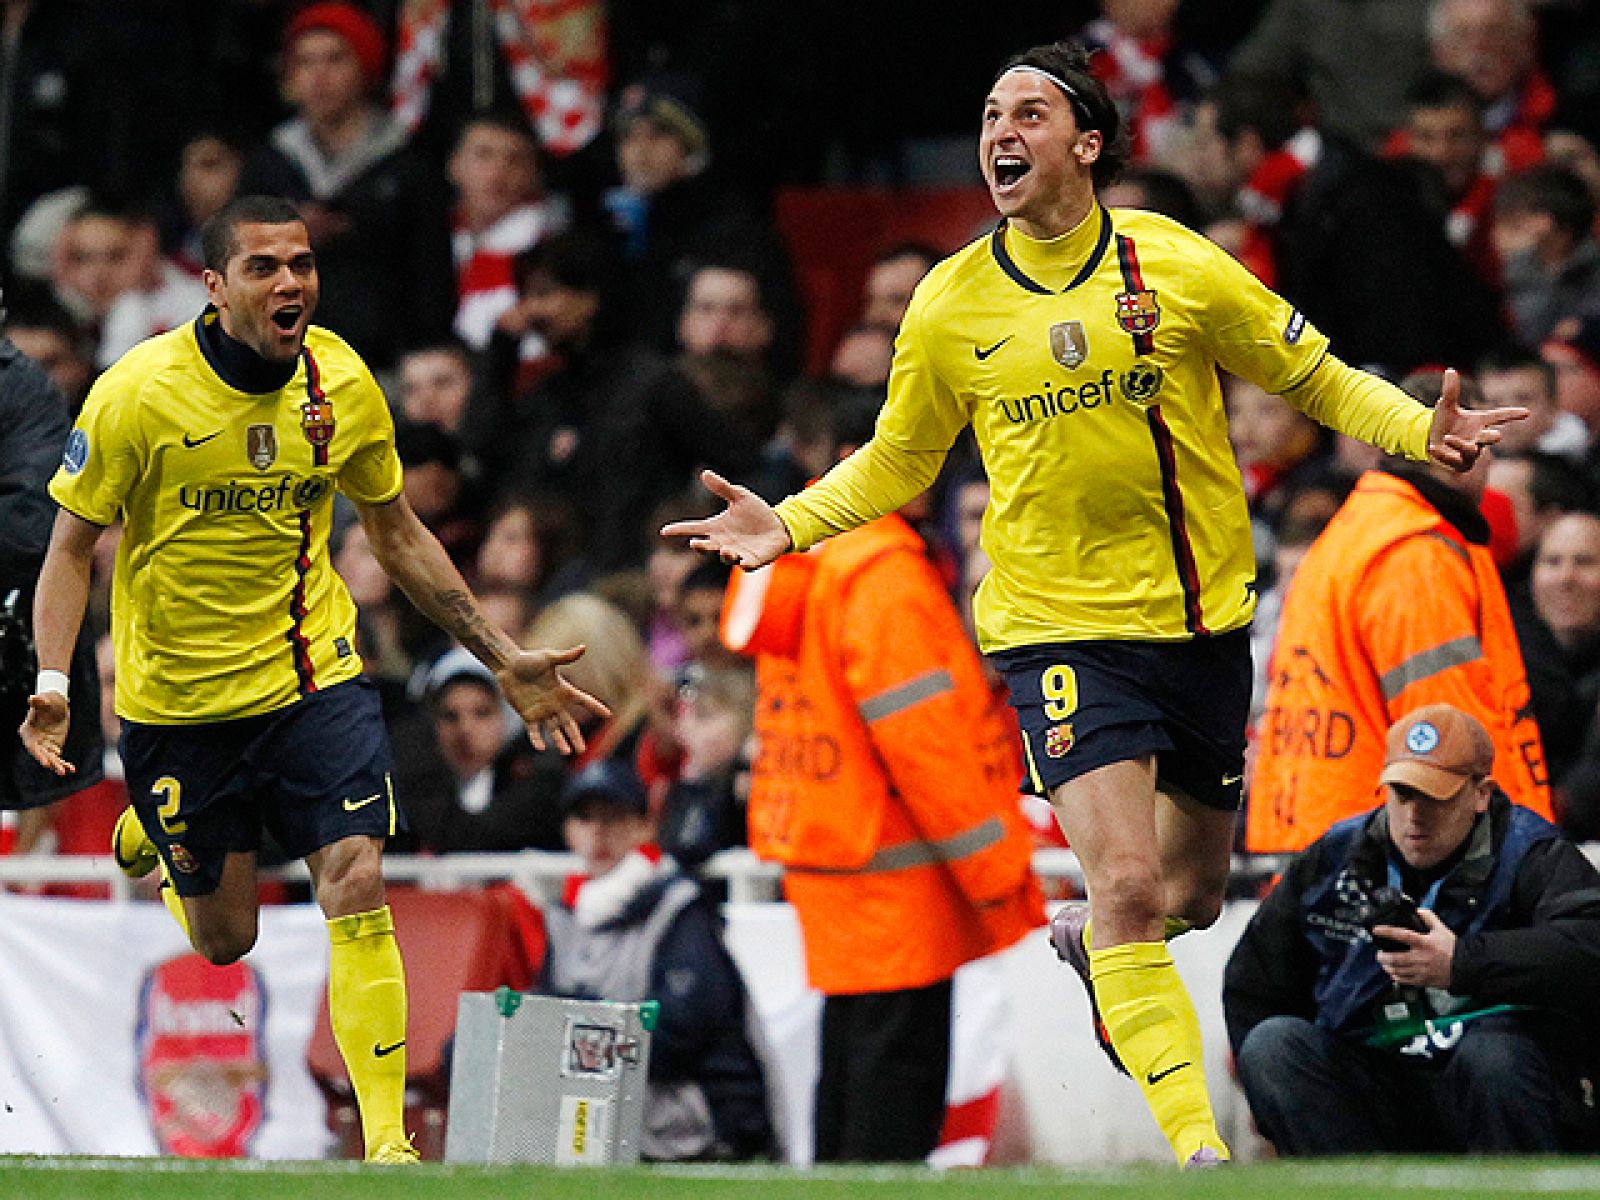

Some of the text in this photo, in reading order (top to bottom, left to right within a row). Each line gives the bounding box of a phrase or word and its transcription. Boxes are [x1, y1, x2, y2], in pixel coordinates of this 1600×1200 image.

[1000, 369, 1114, 424] unicef
[179, 474, 291, 512] unicef
[1041, 664, 1078, 721] 9
[150, 775, 188, 835] 2
